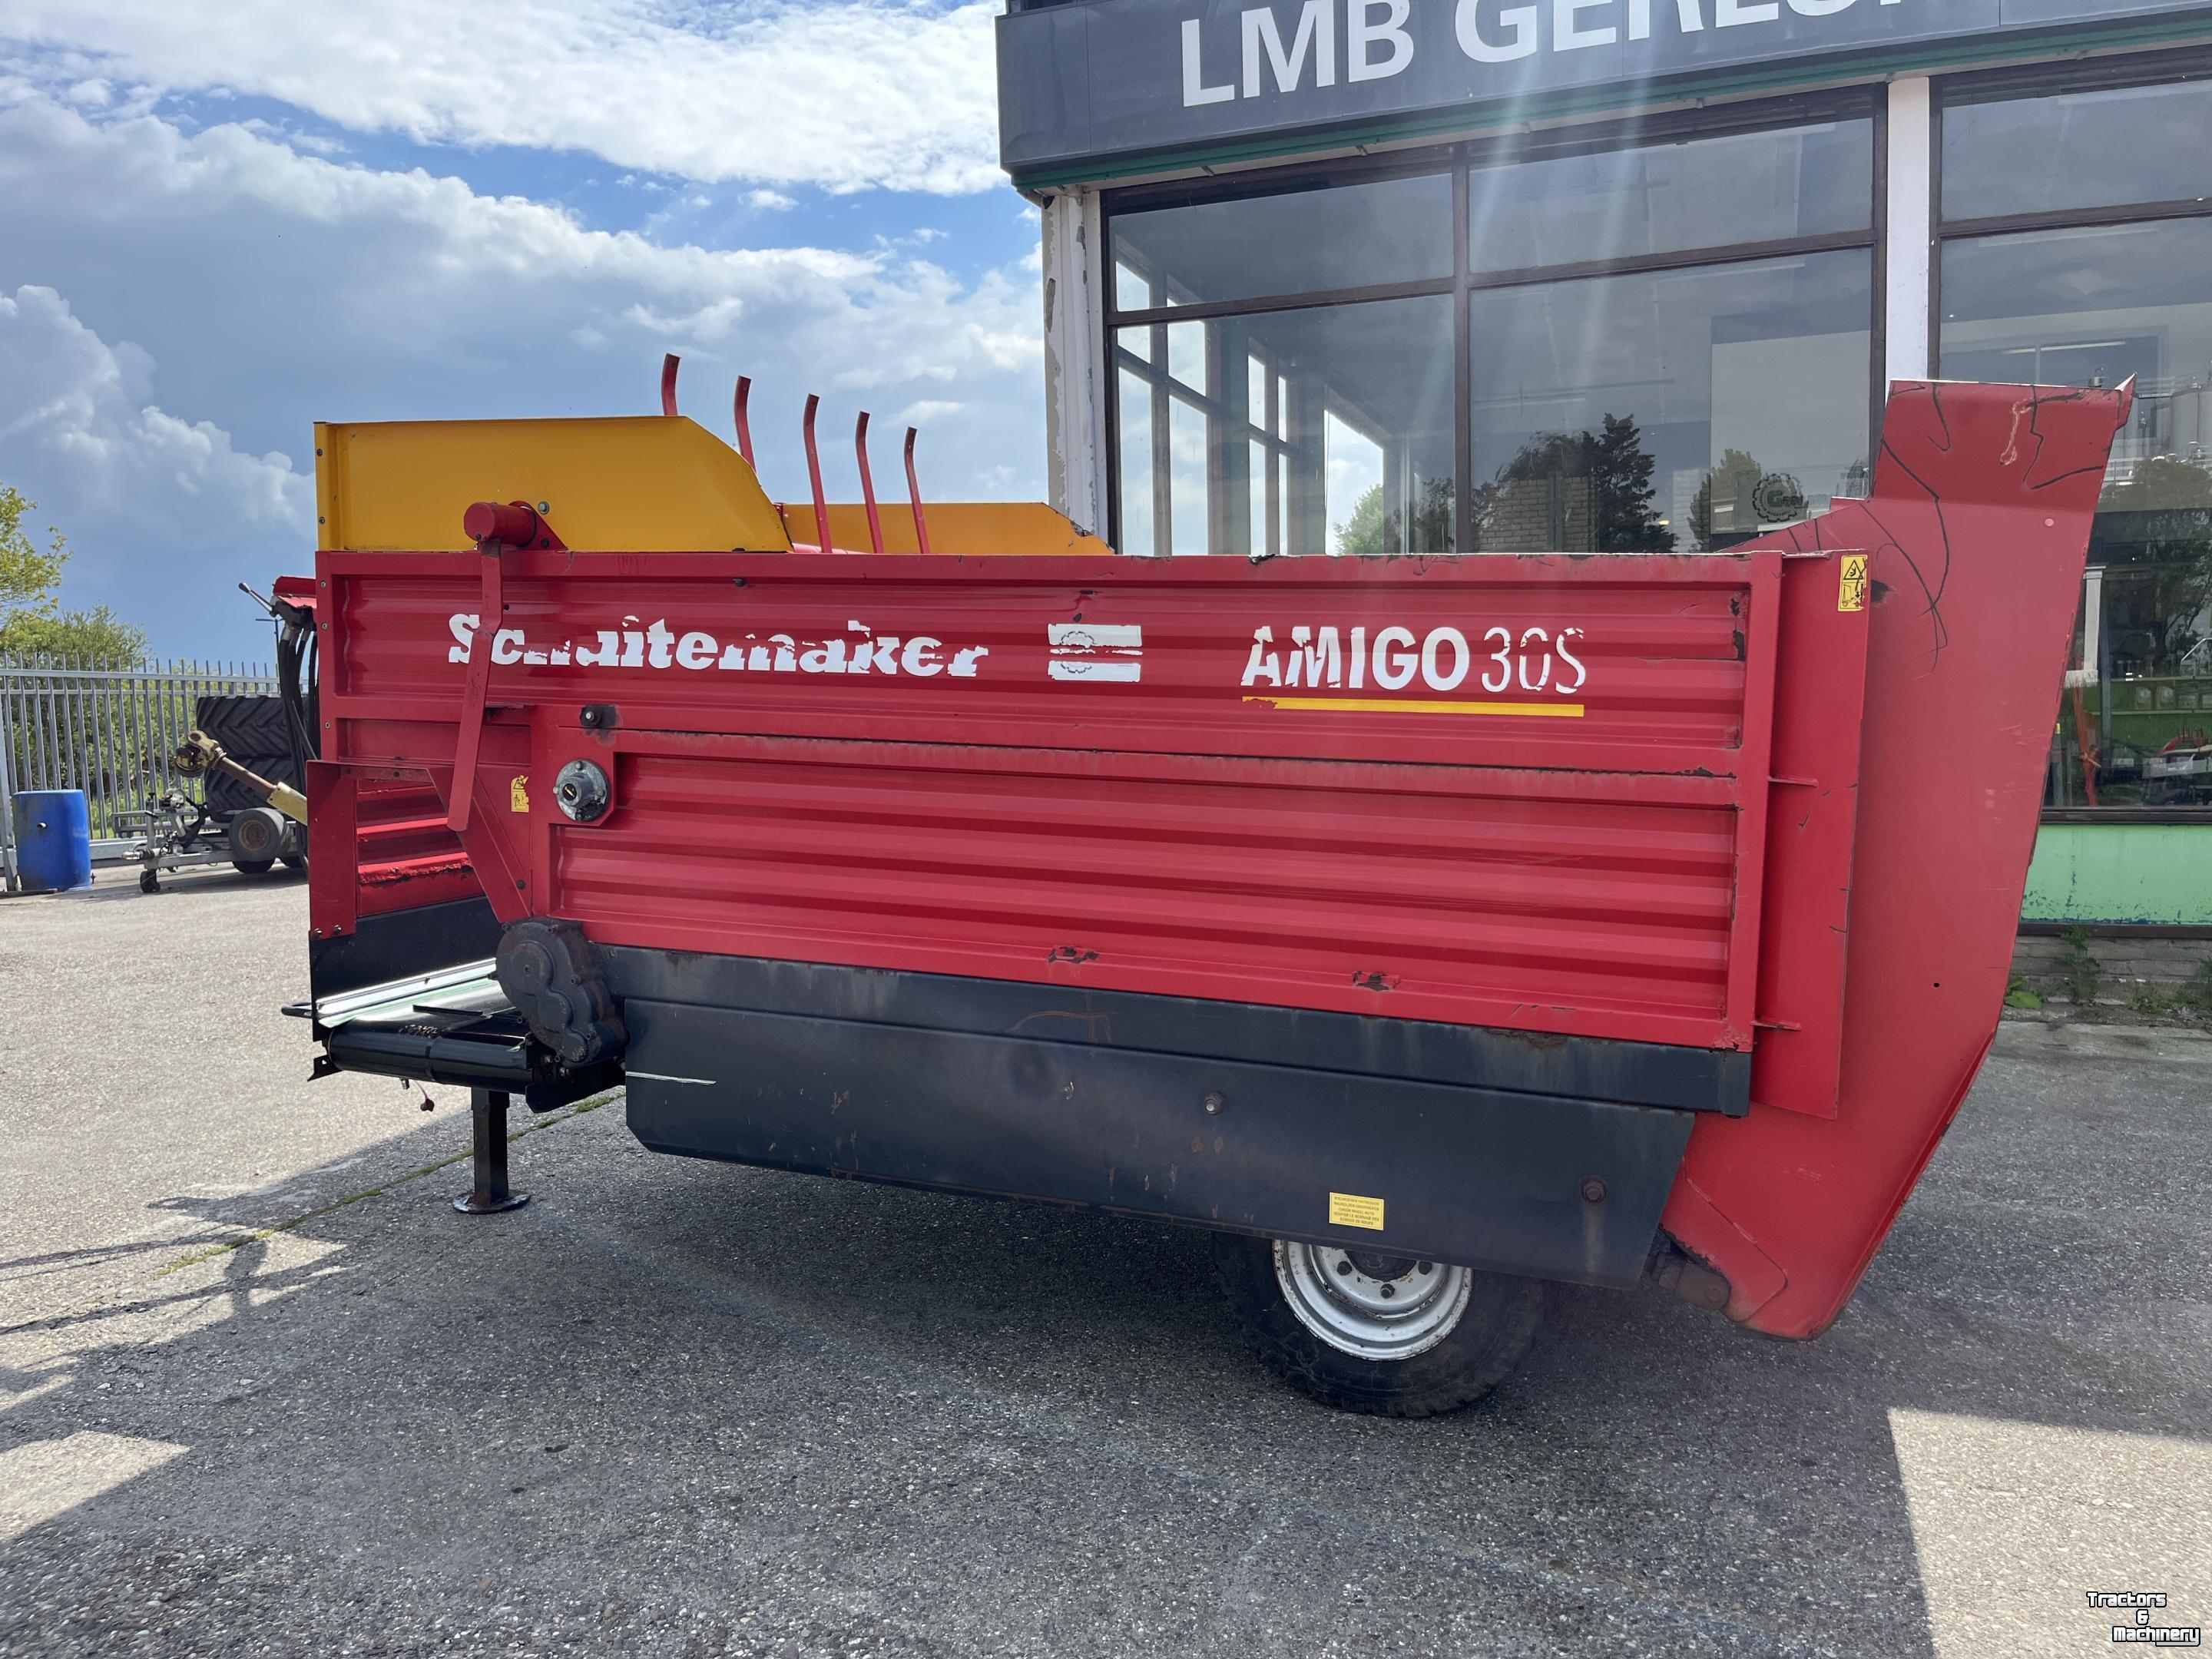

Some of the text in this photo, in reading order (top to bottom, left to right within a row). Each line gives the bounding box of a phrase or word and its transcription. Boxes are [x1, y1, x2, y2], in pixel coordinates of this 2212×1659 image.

[1181, 0, 1416, 108] LMB
[1240, 625, 1586, 694] AMIGO 30S
